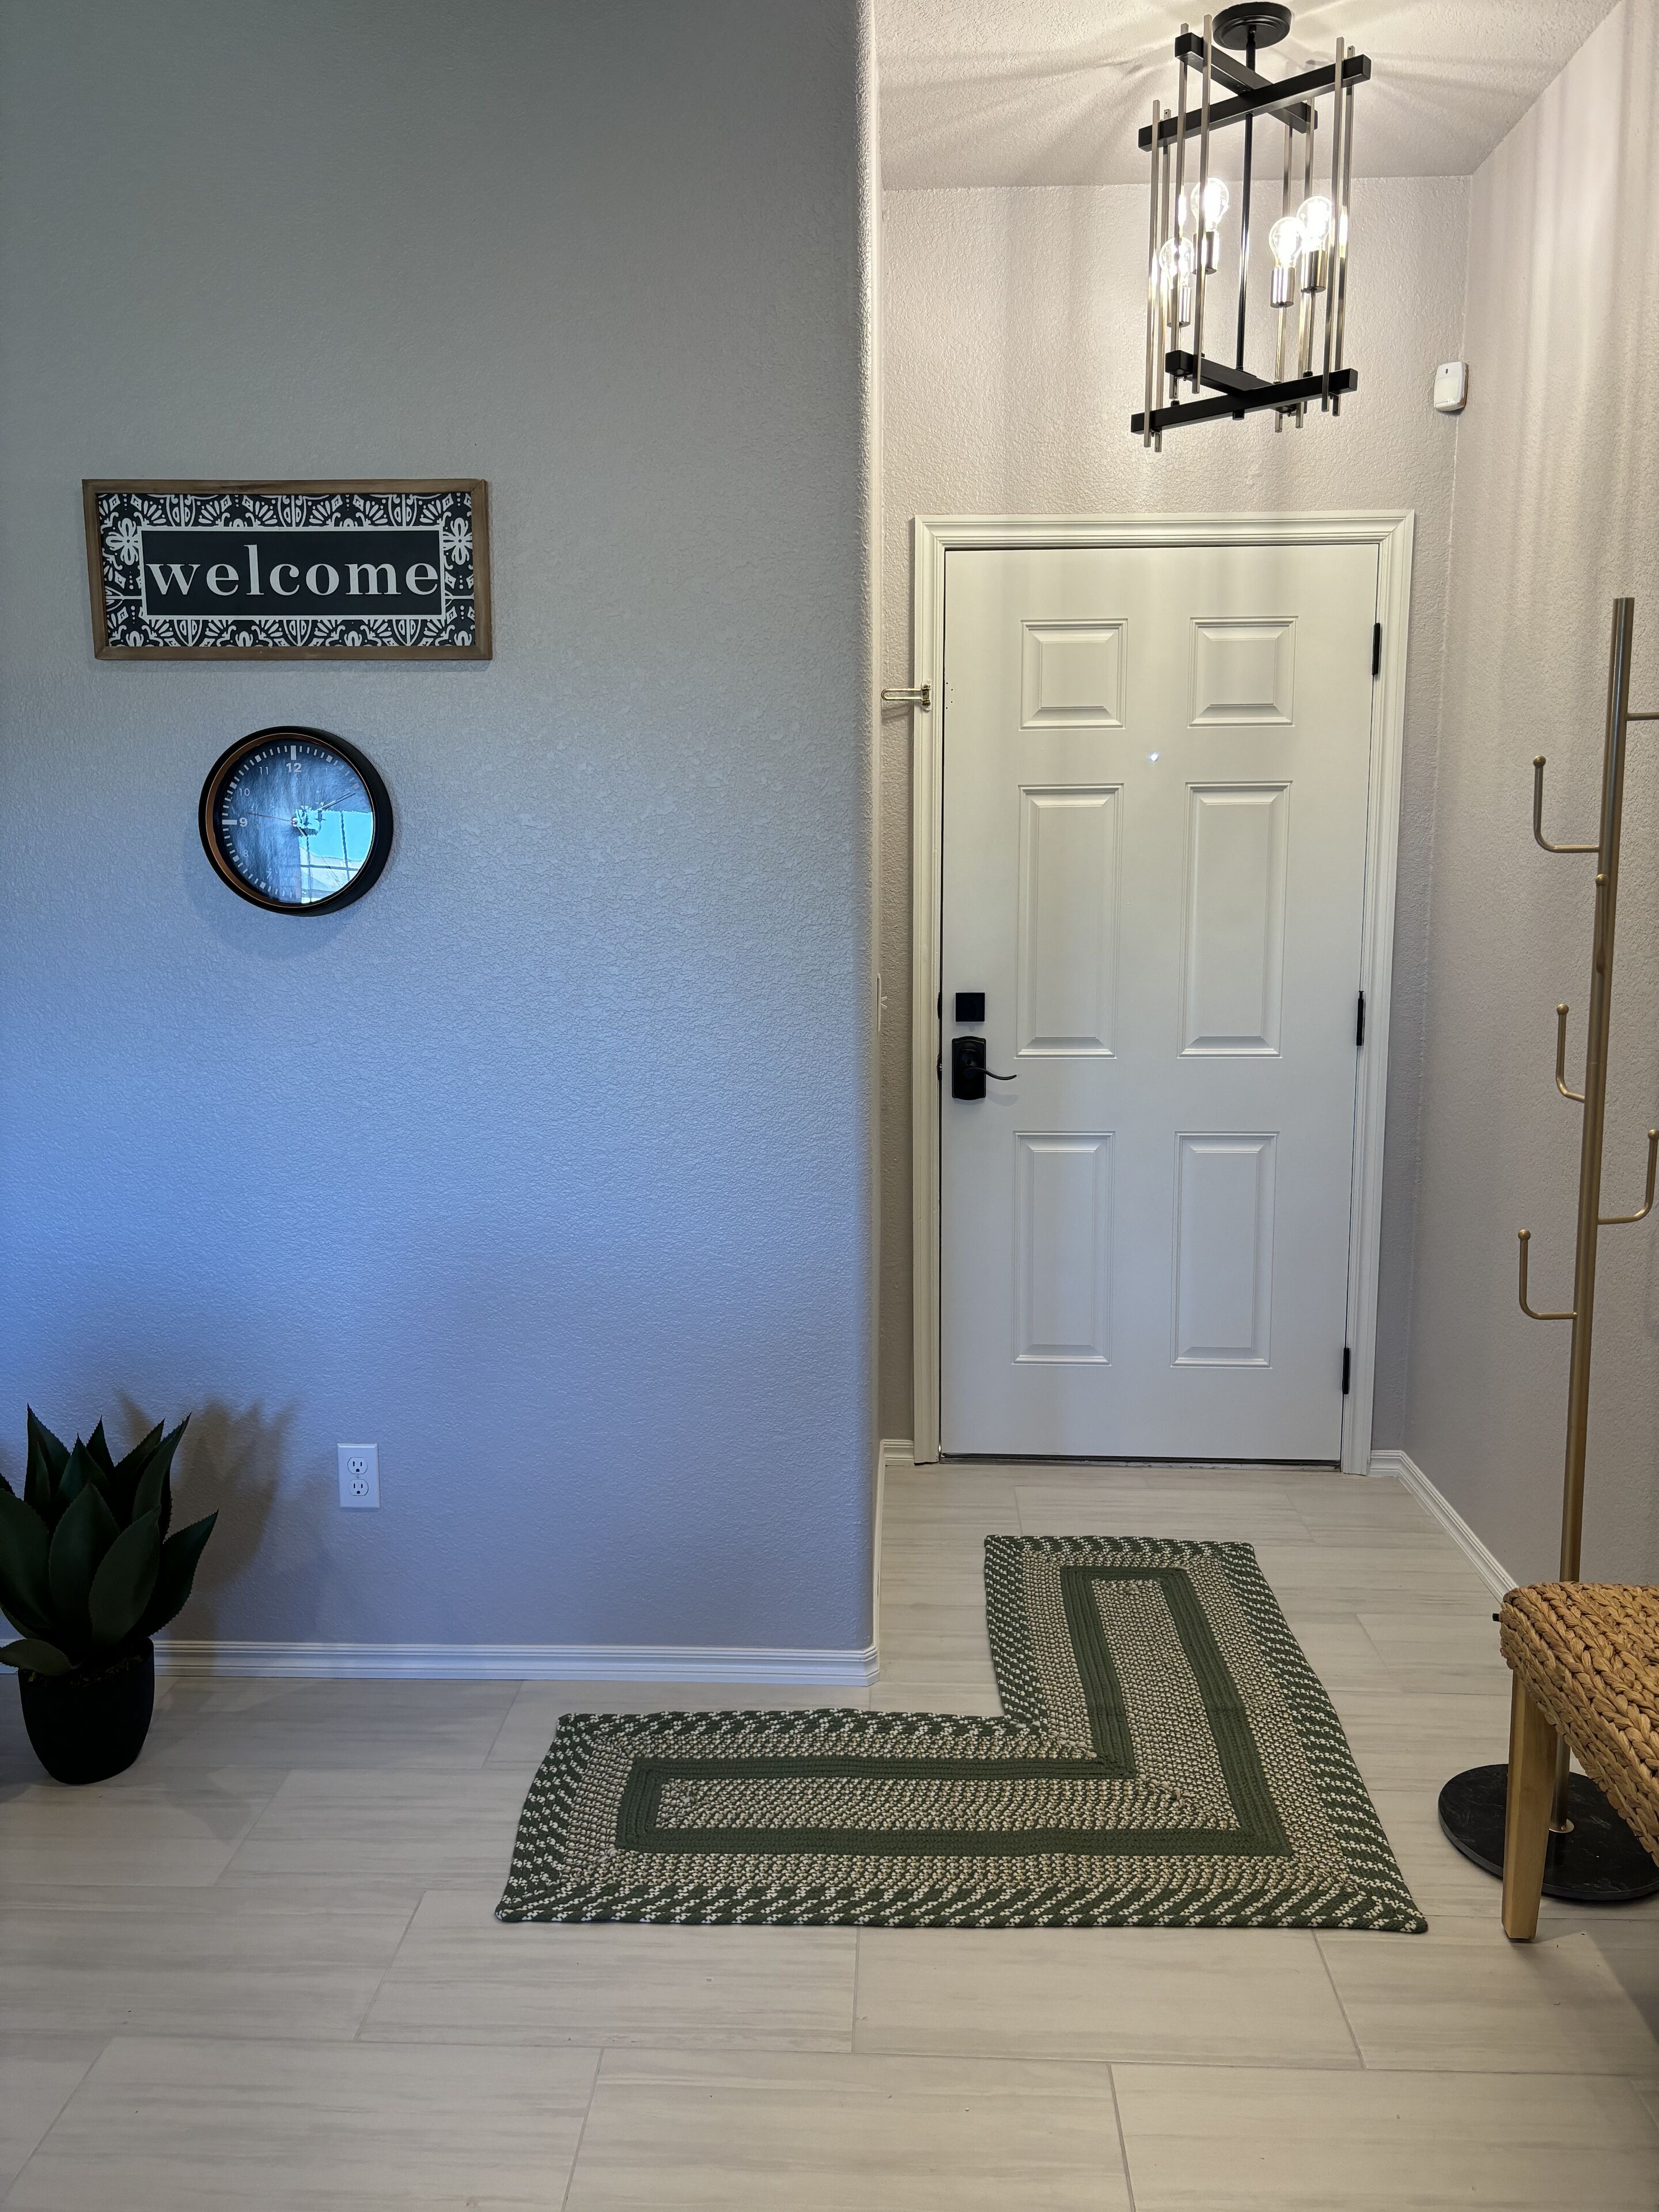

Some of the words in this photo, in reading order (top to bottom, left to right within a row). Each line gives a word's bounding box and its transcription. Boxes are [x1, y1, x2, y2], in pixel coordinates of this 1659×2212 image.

[146, 544, 438, 596] welcome
[259, 766, 268, 775] 11
[286, 762, 302, 772] 12
[239, 788, 250, 796] 10
[239, 817, 248, 827] 9
[243, 849, 249, 858] 8
[266, 870, 272, 879] 7
